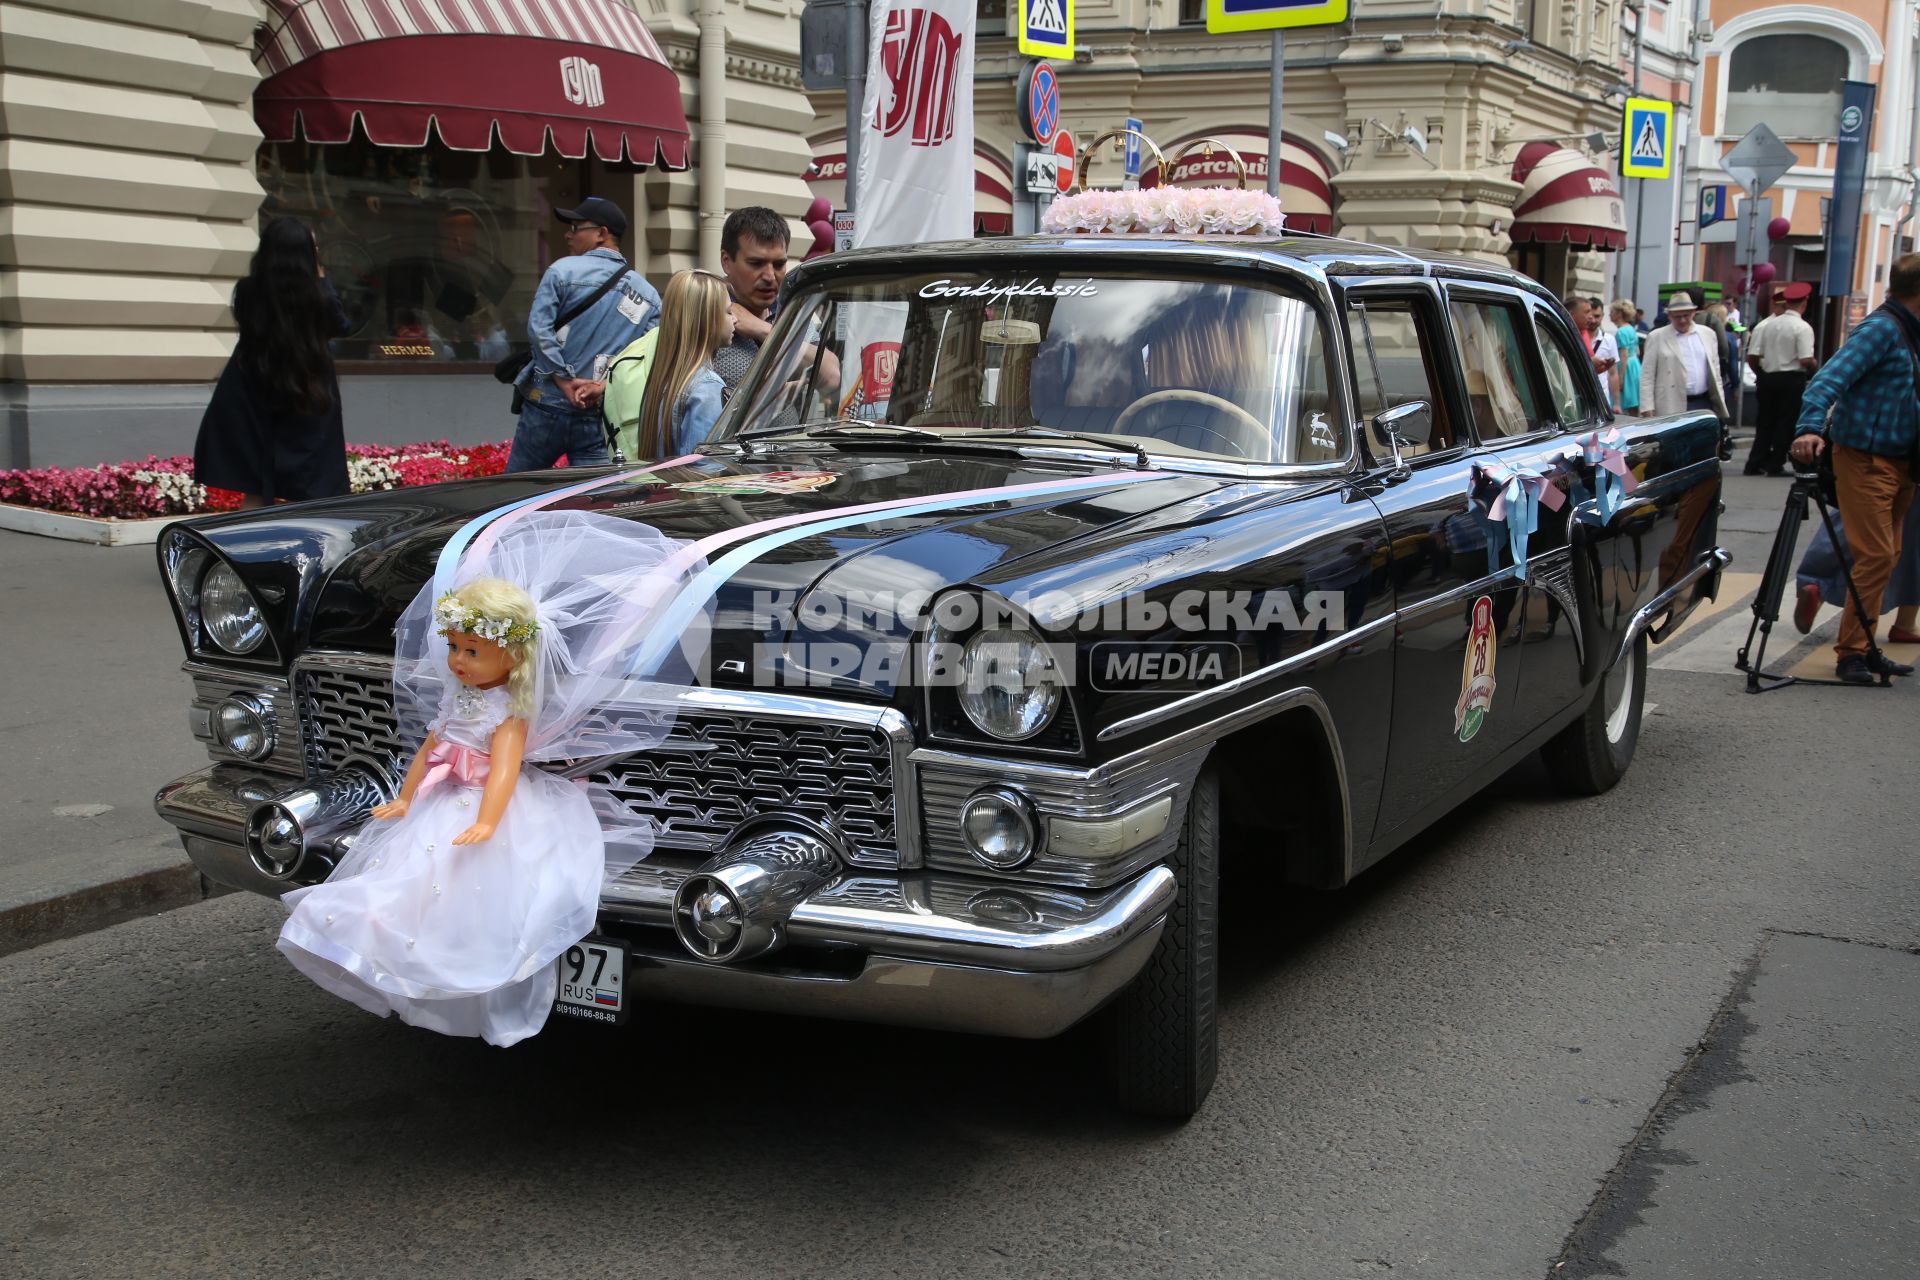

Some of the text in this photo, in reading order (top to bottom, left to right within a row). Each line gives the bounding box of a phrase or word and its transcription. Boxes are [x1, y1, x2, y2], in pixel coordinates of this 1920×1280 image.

[919, 277, 1098, 306] Gorkyclassic
[1311, 436, 1336, 449] ГАЗ
[1472, 642, 1486, 678] 28
[566, 945, 608, 987] 97
[563, 984, 594, 1001] RUS
[556, 1003, 616, 1022] 8(916)166-88-88
